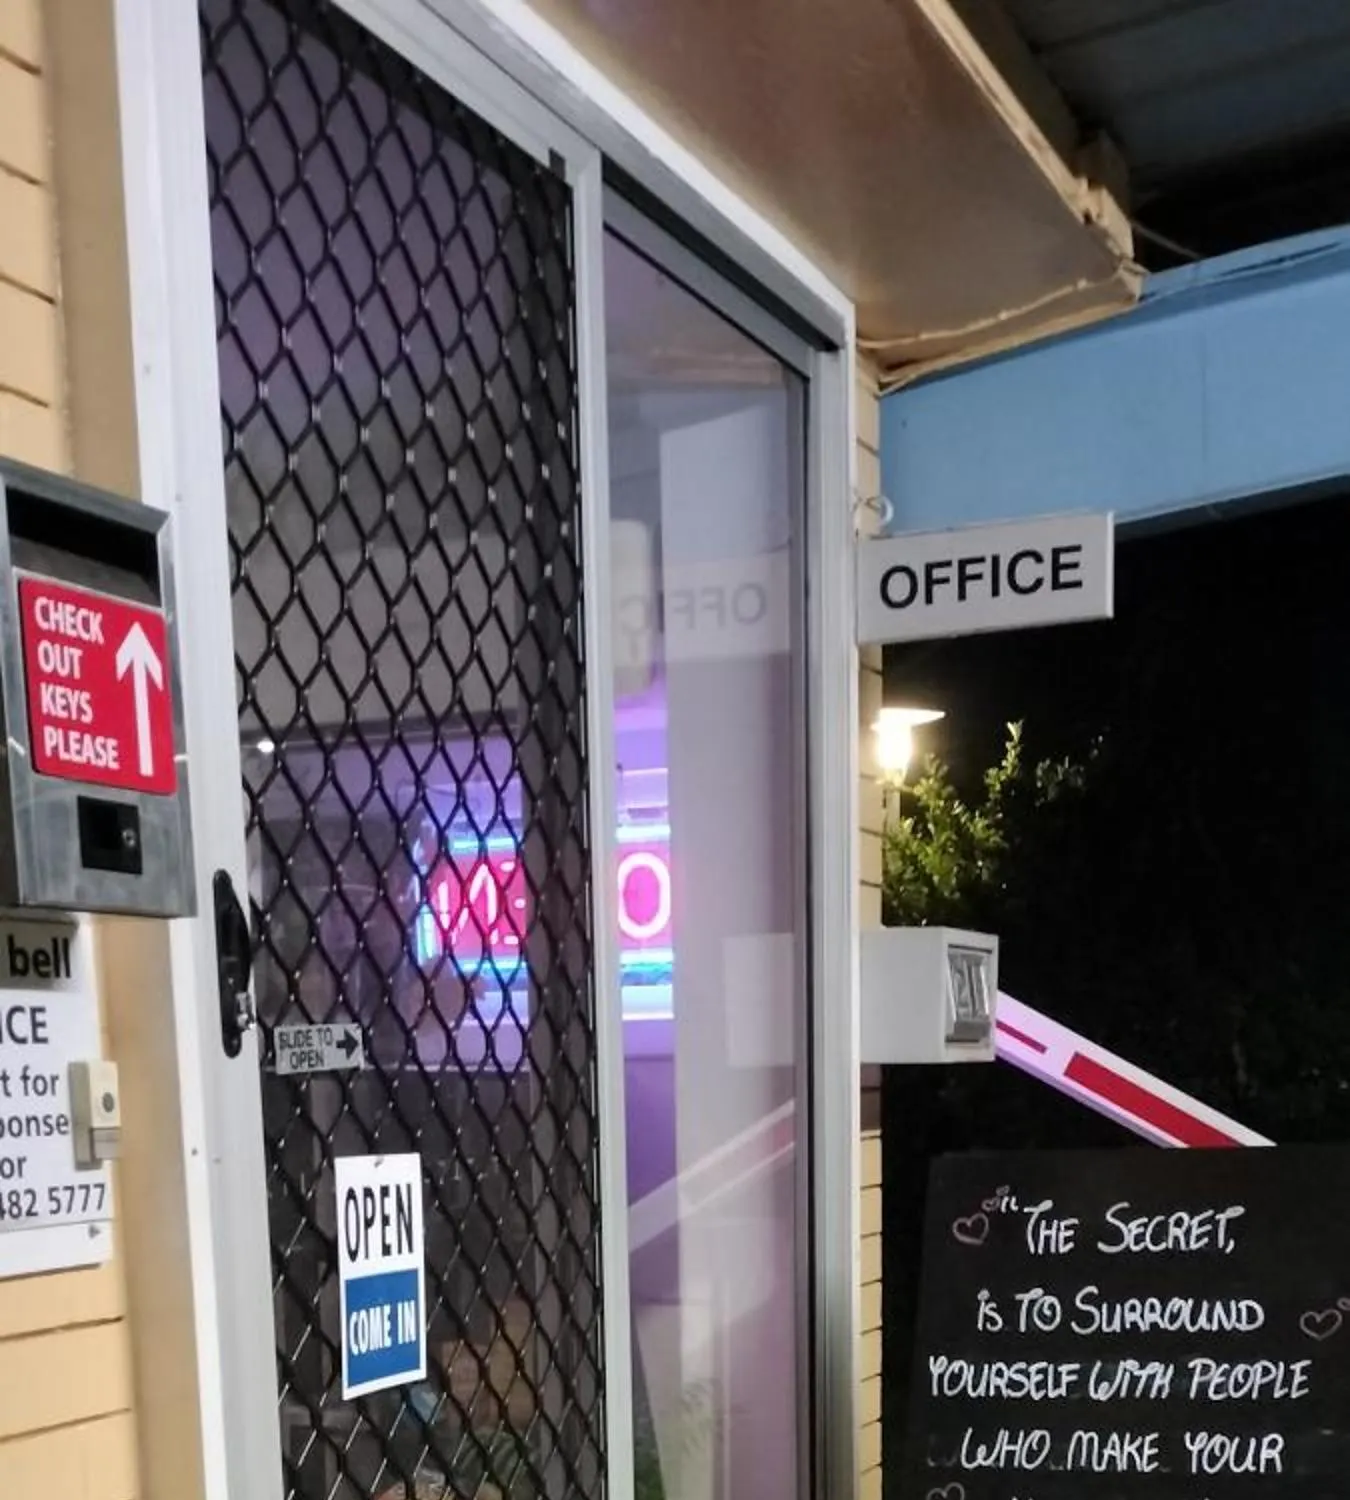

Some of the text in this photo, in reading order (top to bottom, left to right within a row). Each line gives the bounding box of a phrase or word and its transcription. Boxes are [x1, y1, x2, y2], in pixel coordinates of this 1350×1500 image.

[880, 544, 1083, 610] OFFICE
[34, 597, 104, 645] CHECK
[37, 640, 82, 680] OUT
[40, 682, 93, 723] KEYS
[44, 726, 120, 770] PLEASE
[7, 933, 71, 978] bell
[316, 1027, 333, 1046] TO
[20, 1064, 59, 1096] for
[290, 1049, 324, 1070] OPEN
[0, 1113, 69, 1139] onse
[48, 1183, 105, 1215] 5777
[345, 1183, 413, 1262] OPEN
[1097, 1201, 1245, 1254] SECRET,
[349, 1301, 416, 1356] COME IN
[1015, 1287, 1062, 1332] TO
[1071, 1285, 1265, 1335] SURROUND
[929, 1355, 1080, 1400] YOURSELF
[1188, 1358, 1312, 1401] PEOPLE
[961, 1427, 1285, 1474] WHO MAKE YOUR
